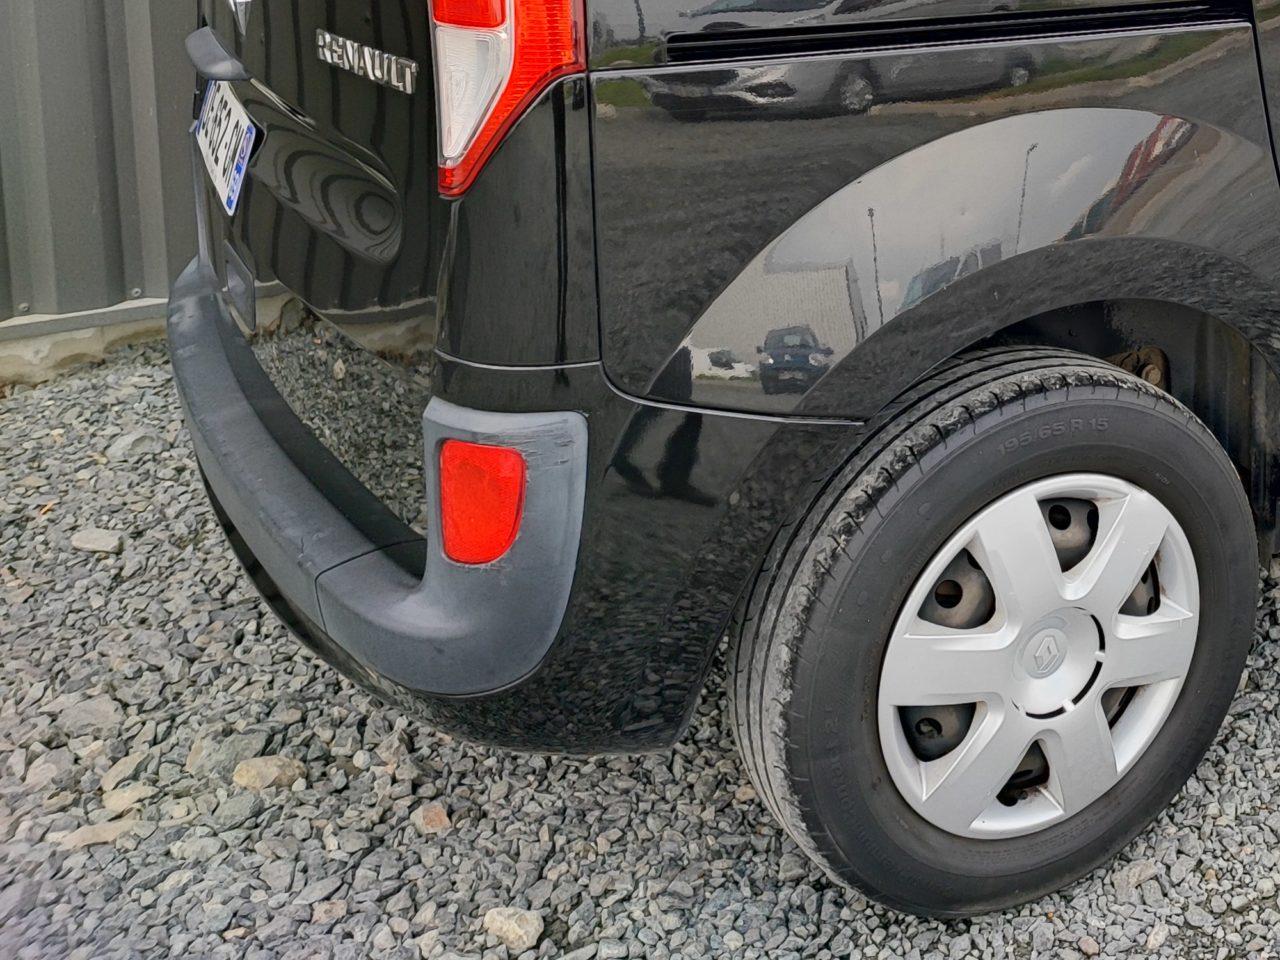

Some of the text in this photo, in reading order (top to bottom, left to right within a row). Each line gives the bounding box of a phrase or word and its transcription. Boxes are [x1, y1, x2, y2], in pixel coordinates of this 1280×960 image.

[316, 28, 419, 95] RENAULT
[1070, 418, 1085, 432] R
[1088, 417, 1109, 431] 15
